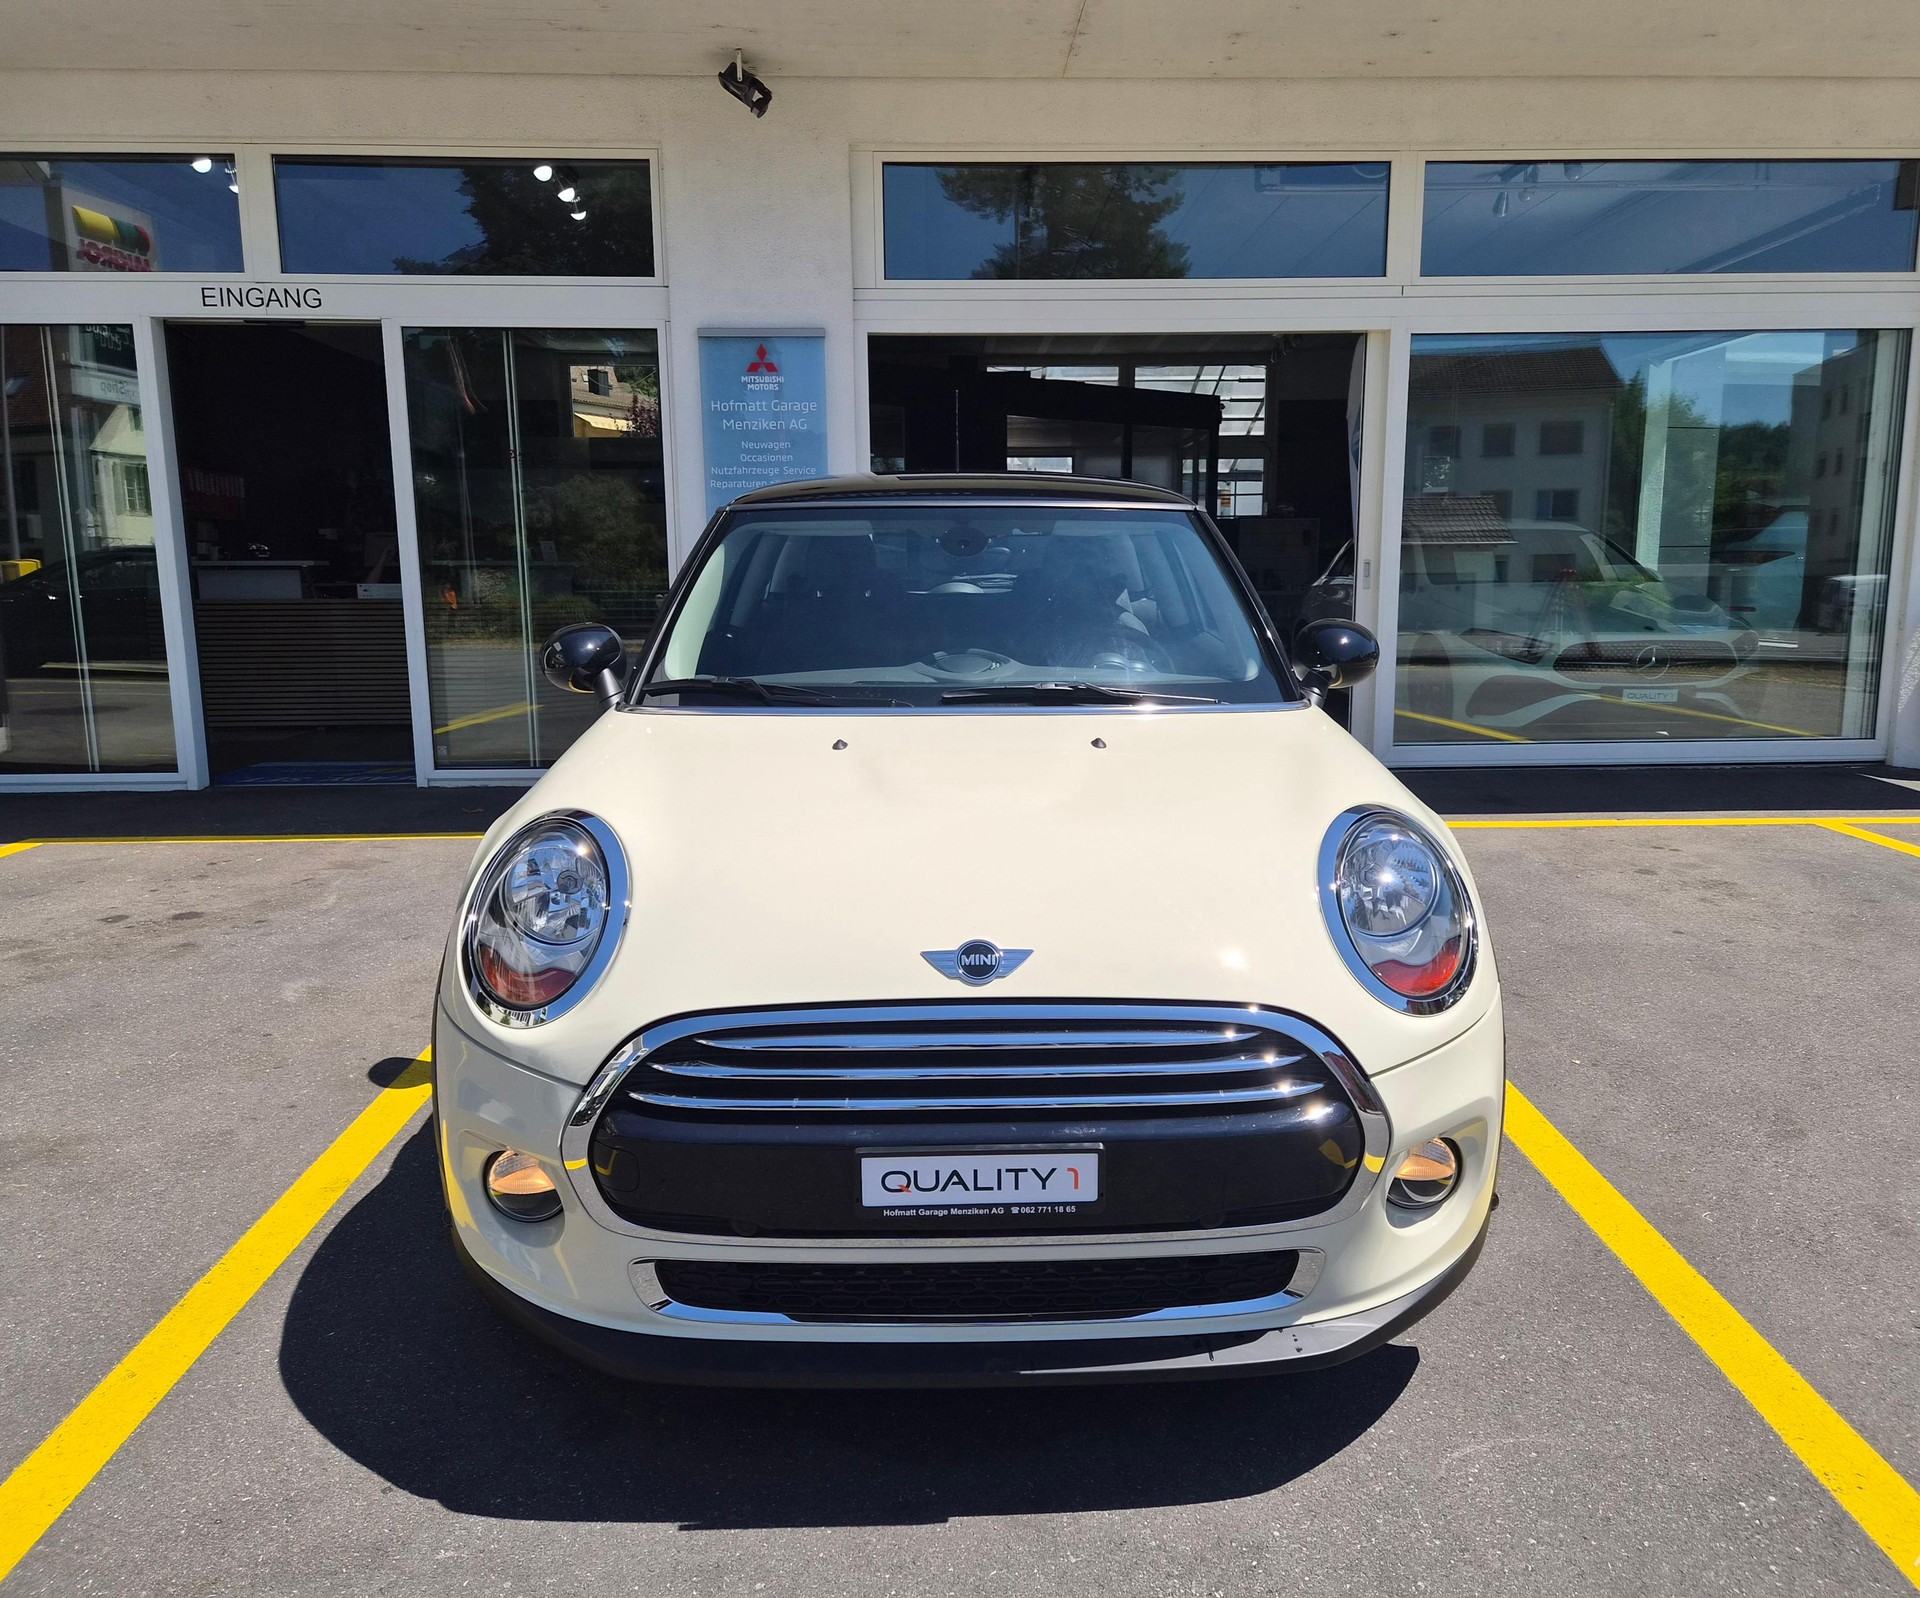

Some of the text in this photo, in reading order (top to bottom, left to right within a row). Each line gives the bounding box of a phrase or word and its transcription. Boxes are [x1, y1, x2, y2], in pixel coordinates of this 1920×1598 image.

[201, 287, 322, 309] EINGANG
[747, 383, 779, 391] MOTORS
[711, 400, 818, 413] Hofmatt Garage
[722, 418, 808, 430] Menziken AG
[741, 441, 791, 450] Neuwagen
[740, 453, 793, 462] Occasionen
[711, 466, 816, 476] Nutzfahrzeuge Service
[710, 480, 768, 489] Reparaturen
[961, 953, 996, 966] MINI
[880, 1167, 1081, 1193] QUALITY 1
[883, 1205, 1076, 1217] Hofmatt Garage Menziken AG 062 771 18 65
